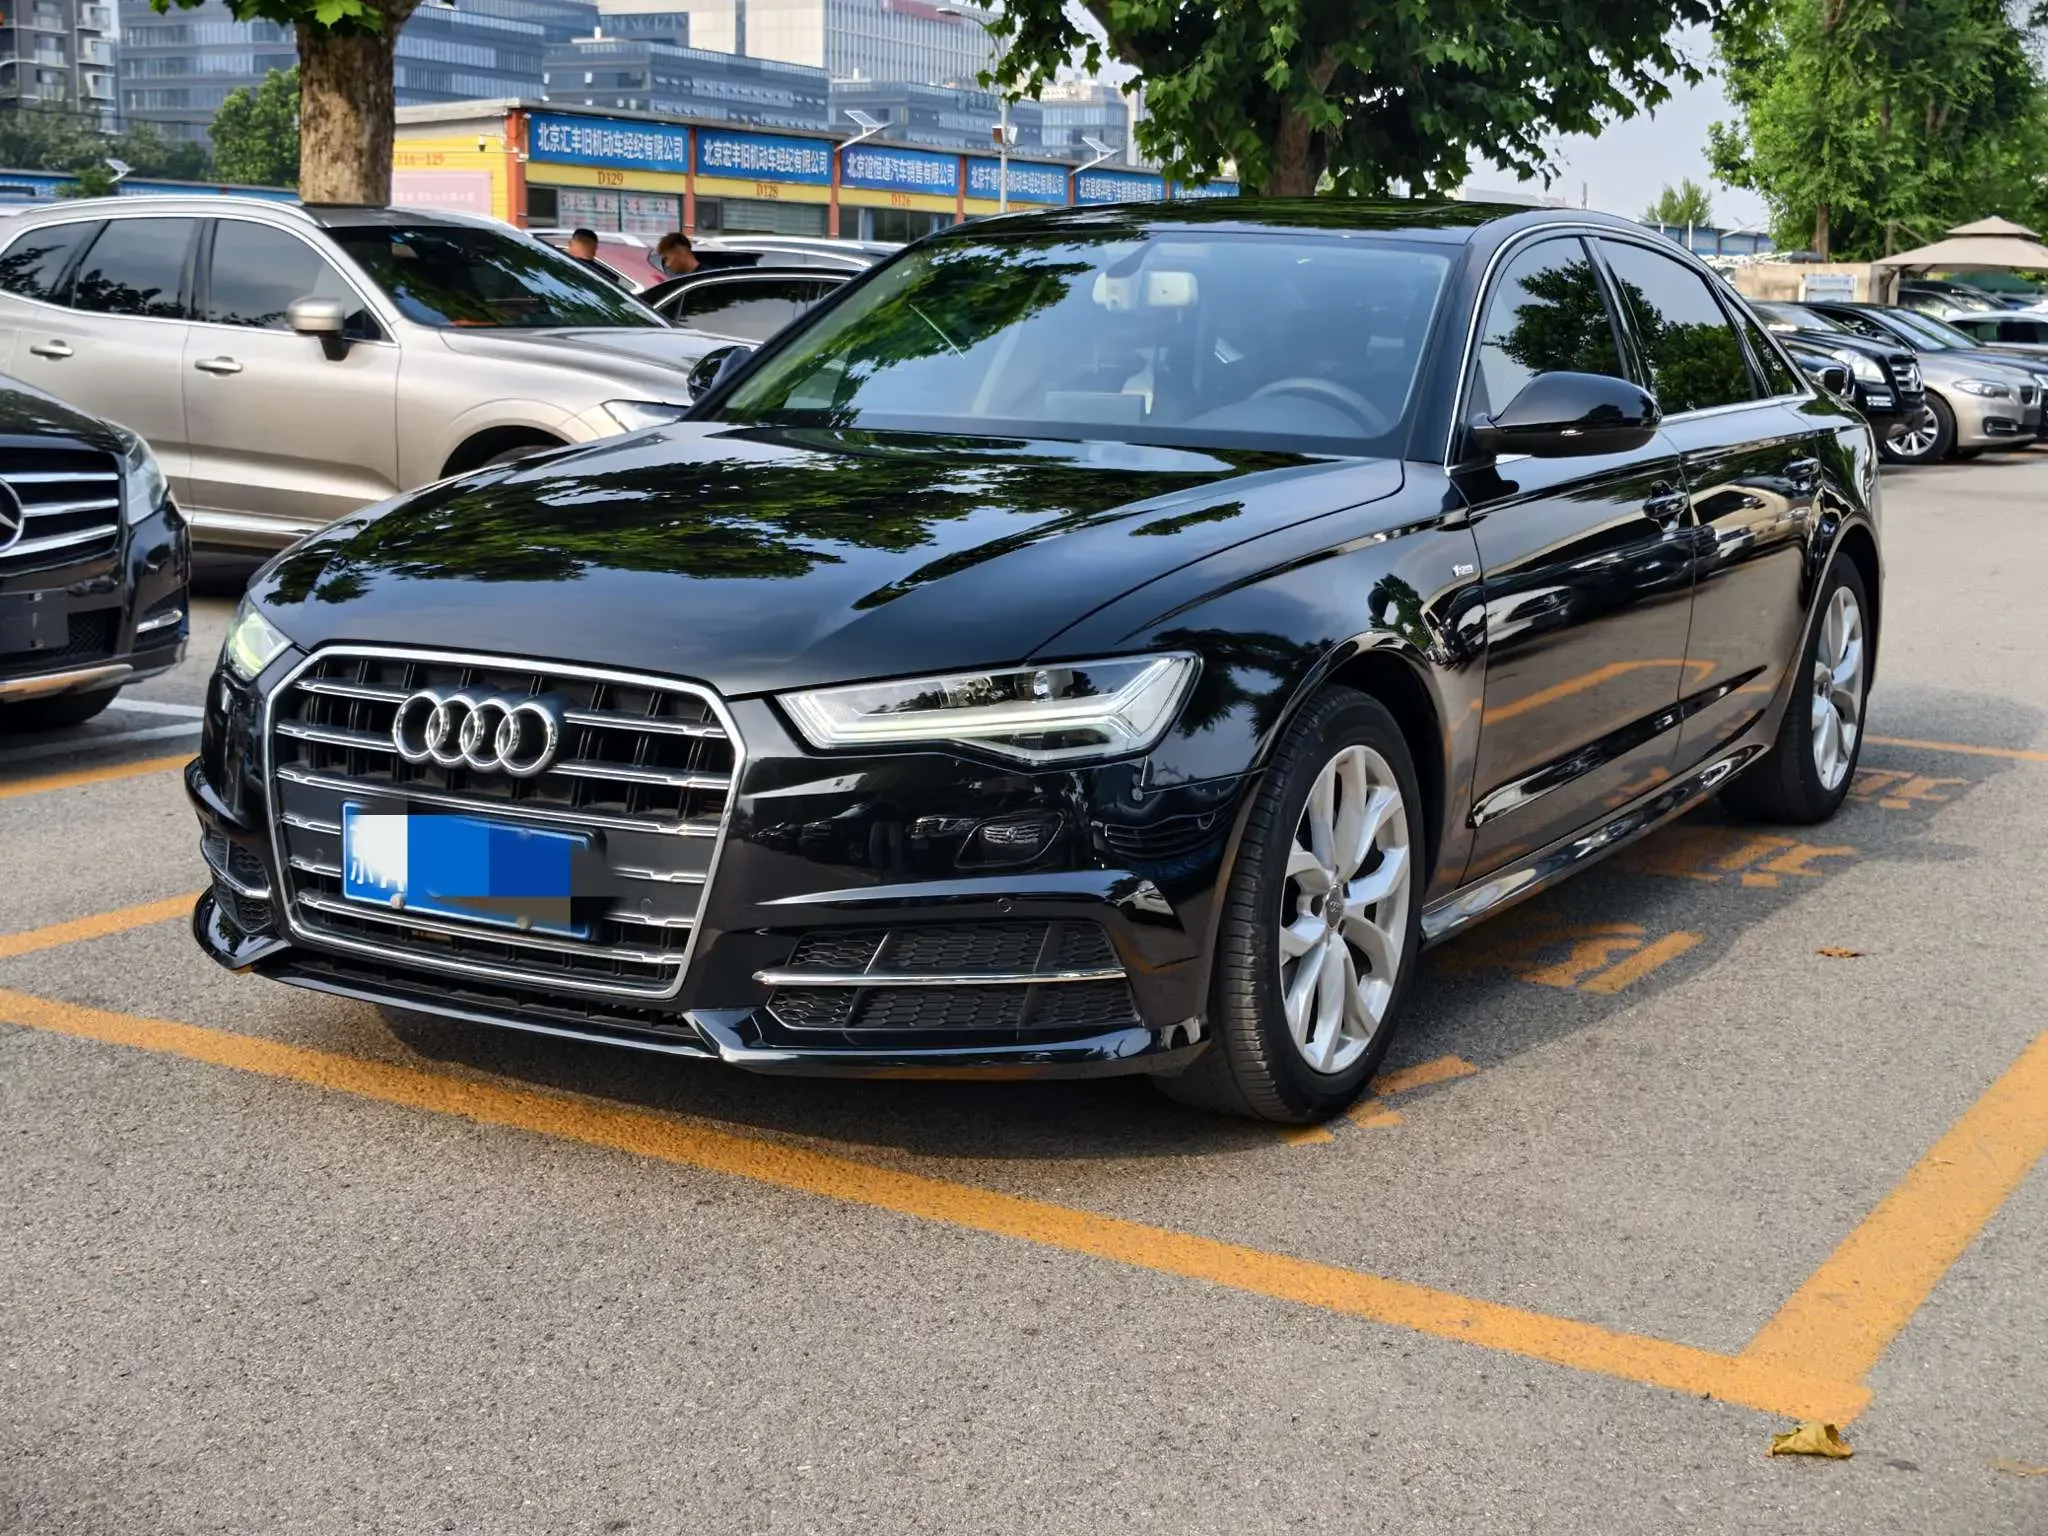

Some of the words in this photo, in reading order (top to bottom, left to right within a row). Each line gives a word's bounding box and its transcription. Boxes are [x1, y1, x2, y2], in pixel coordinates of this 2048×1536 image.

[537, 122, 683, 162] 北京汇丰旧机动车经纪有限公司
[597, 170, 623, 185] D129
[756, 184, 778, 198] D128
